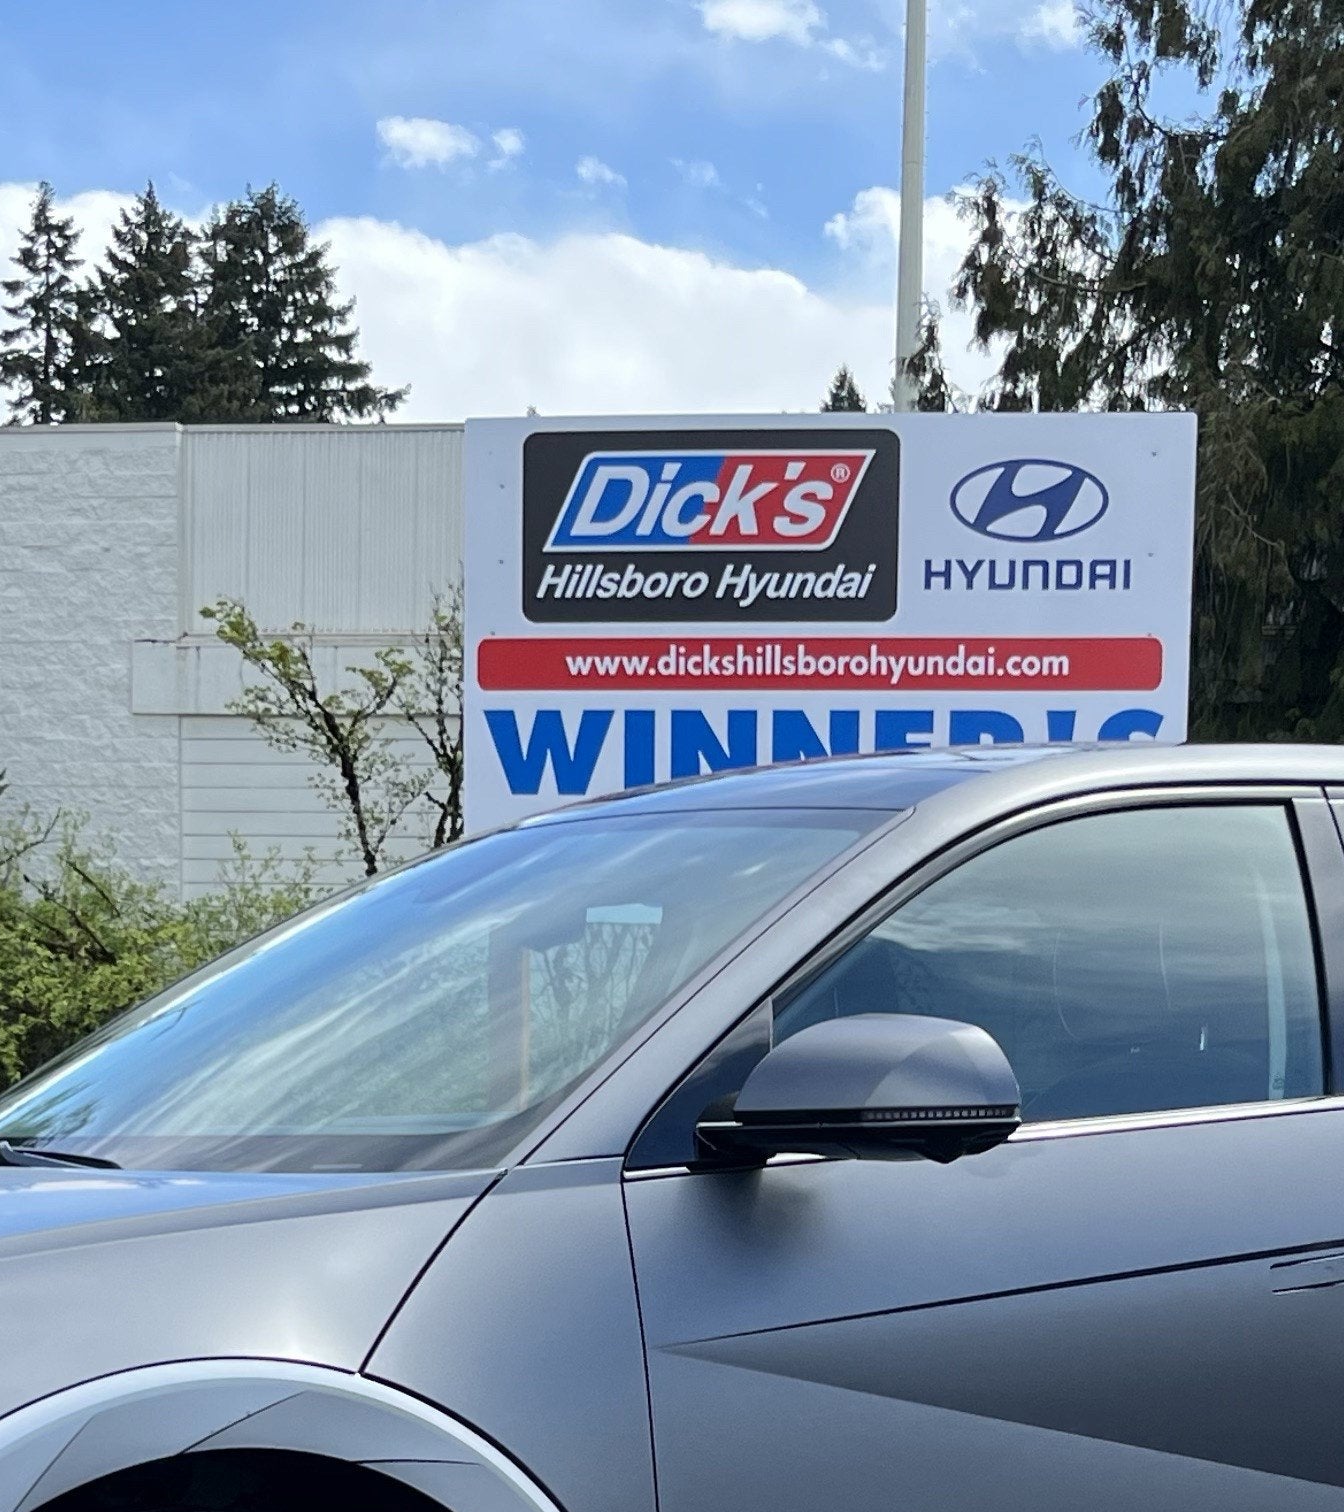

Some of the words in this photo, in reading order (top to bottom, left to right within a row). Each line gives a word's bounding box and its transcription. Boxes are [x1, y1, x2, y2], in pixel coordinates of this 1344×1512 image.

[536, 564, 709, 599] Hillsboro
[715, 563, 877, 608] Hyundai
[924, 558, 1131, 591] HYUNDAI
[565, 643, 1069, 684] www.dickshillsborohyundai.com
